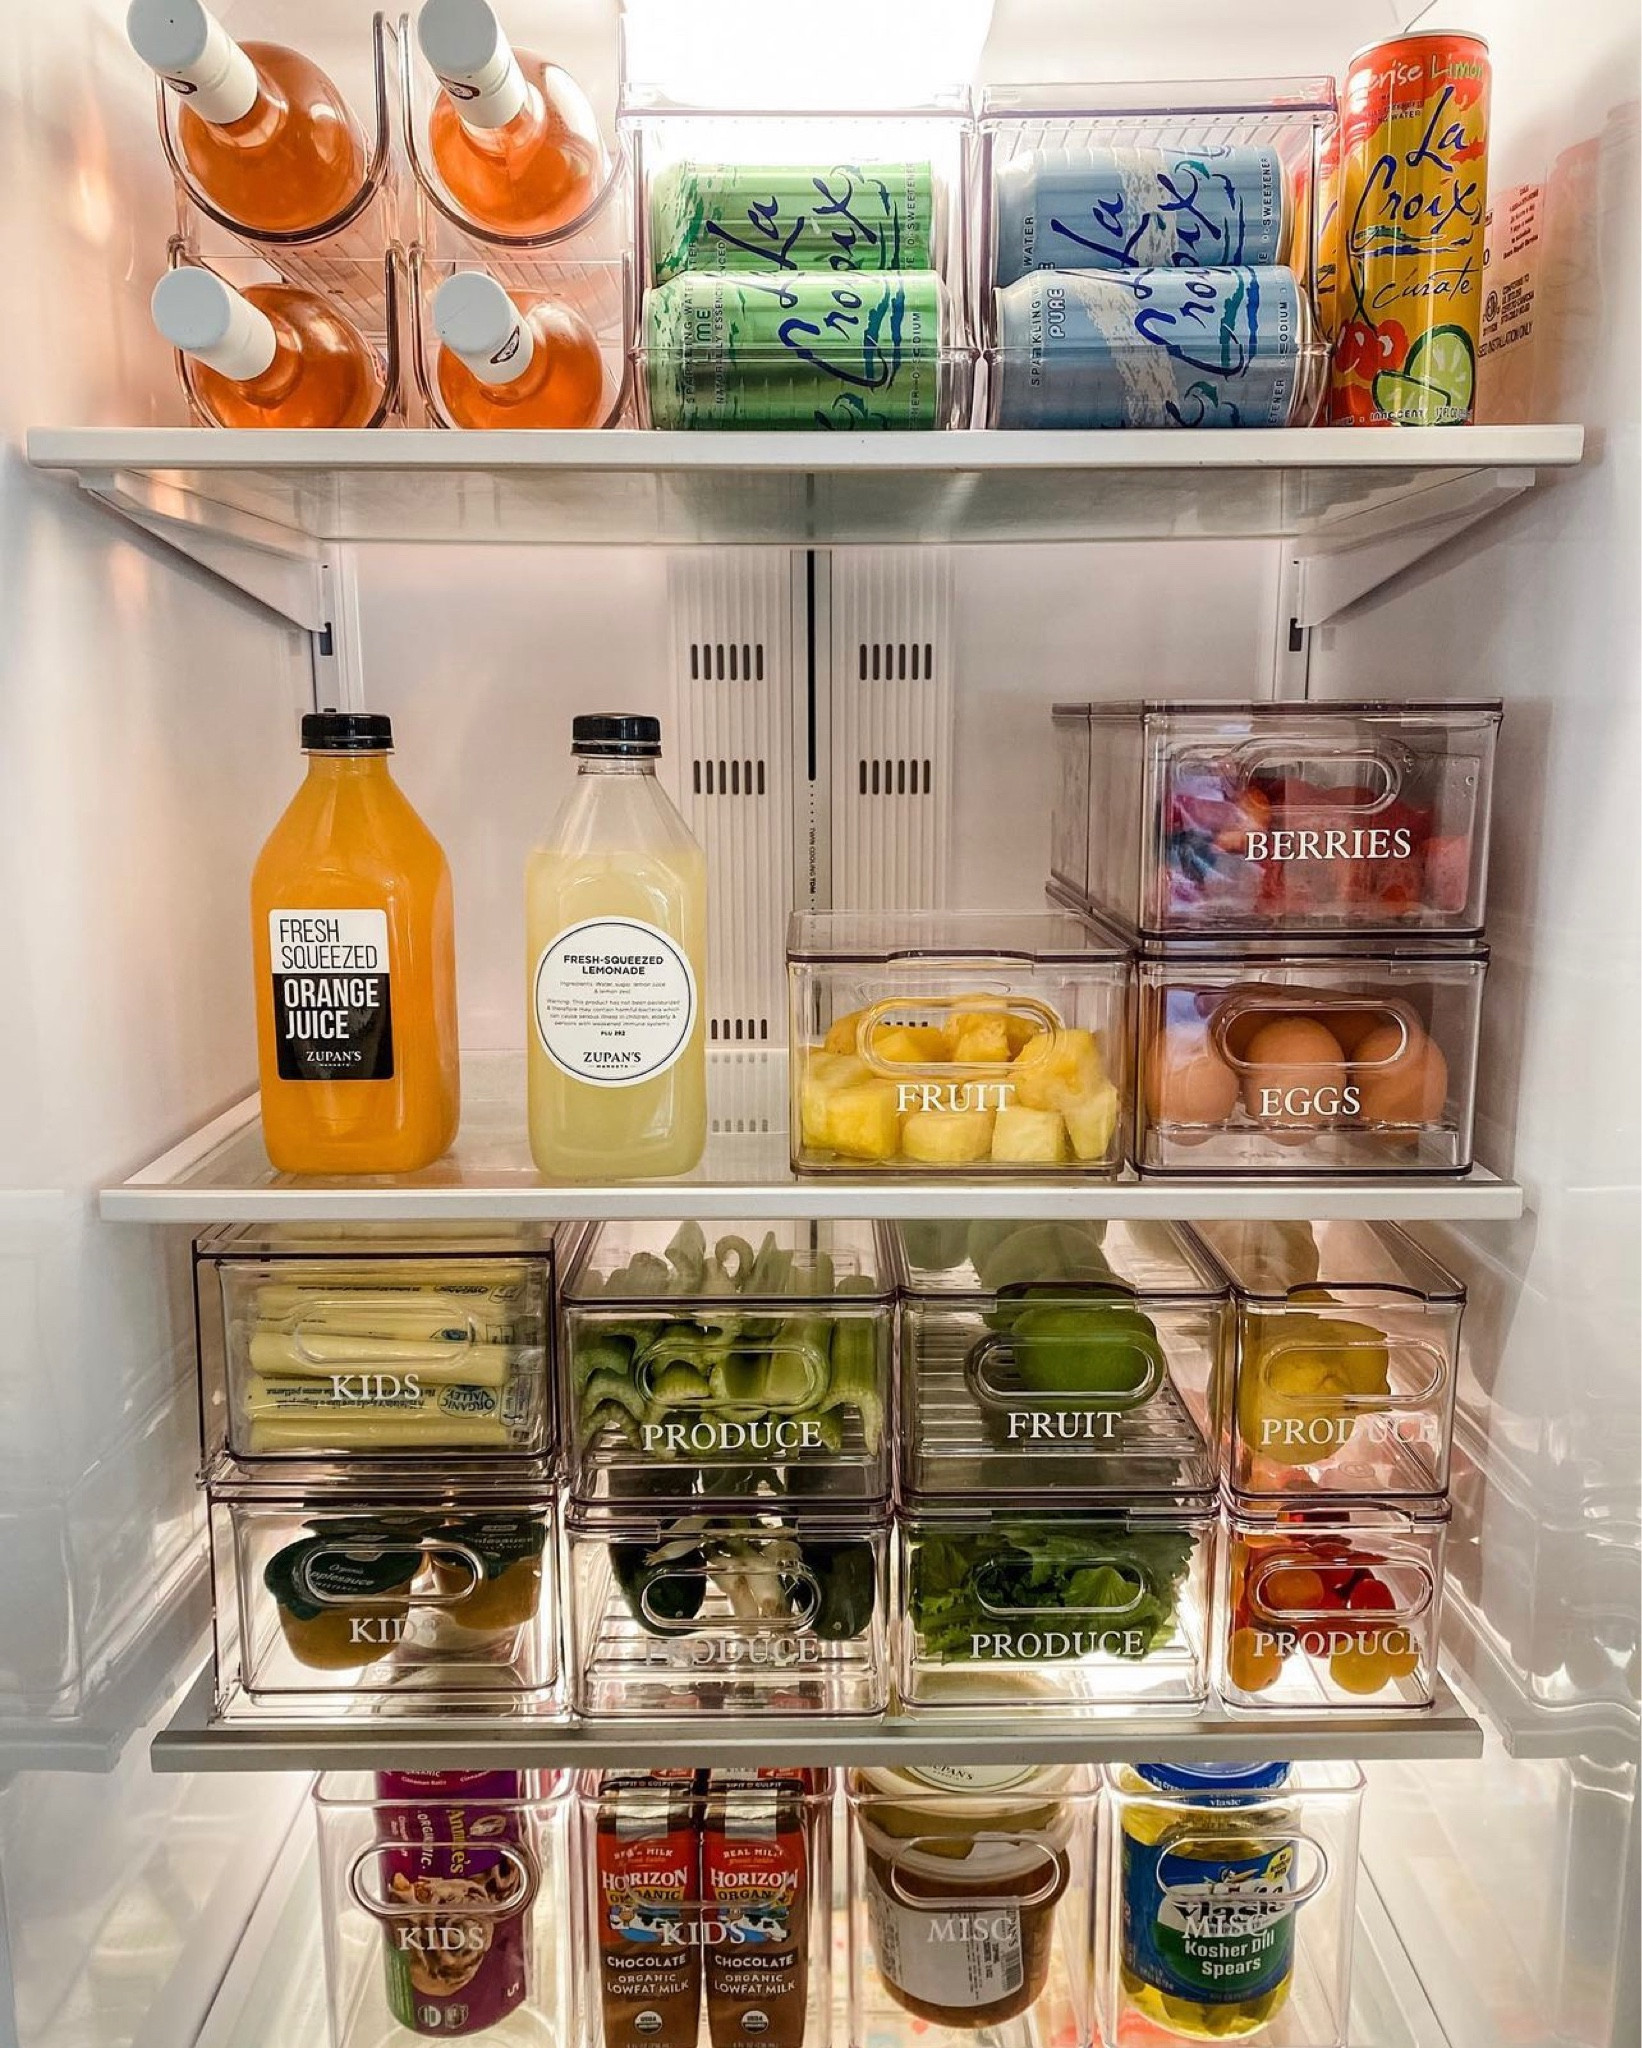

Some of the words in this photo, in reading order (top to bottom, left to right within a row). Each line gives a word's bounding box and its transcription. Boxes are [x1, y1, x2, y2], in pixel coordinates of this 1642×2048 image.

[1406, 85, 1468, 172] La
[1351, 154, 1480, 254] Croix
[1022, 215, 1035, 267] WATER
[1046, 288, 1066, 340] PURE
[1244, 827, 1412, 862] BERRIES
[279, 918, 340, 944] FRESH
[281, 944, 379, 970] SQUEEZED
[563, 954, 664, 965] FRESH-SQUEEZED
[582, 966, 646, 975] LEMONADE
[283, 977, 380, 1009] ORANGE
[285, 1009, 350, 1040] JUICE
[305, 1049, 363, 1063] ZUPAN'S
[583, 1051, 641, 1063] ZUPAN'S
[895, 1083, 1015, 1112] FRUIT
[1259, 1087, 1362, 1118] EGGS
[330, 1373, 421, 1401] KIDS
[643, 1420, 824, 1452] PRODUCE
[1007, 1411, 1122, 1440] FRUIT
[1260, 1418, 1438, 1446] PRODUCE
[969, 1630, 1145, 1659] PRODUCE
[1253, 1630, 1426, 1658] PRODUCE
[646, 1848, 673, 1858] MILK
[723, 1848, 751, 1859] REAL
[602, 1865, 688, 1891] HORIZON
[710, 1866, 799, 1890] HORIZON
[610, 1890, 681, 1905] ORANIC
[718, 1889, 786, 1905] ORGAN
[398, 1927, 485, 1951] KIDS
[660, 1921, 747, 1947] KIDS
[927, 1917, 1013, 1944] MISC
[1182, 1914, 1268, 1939] MISC
[1184, 1940, 1248, 1958] Kosher
[1252, 1929, 1275, 1954] Dill
[607, 1954, 687, 1969] CHOCOLATE
[714, 1954, 794, 1969] CHOCOLATE
[1201, 1957, 1261, 1980] Spears
[607, 1979, 657, 1995] LOWFAT
[659, 1979, 689, 1993] MILK
[618, 1973, 677, 1984] ORGANIC
[714, 1979, 763, 1994] LOWFAT
[765, 1979, 796, 1993] MILK
[725, 1973, 783, 1983] ORGANIC
